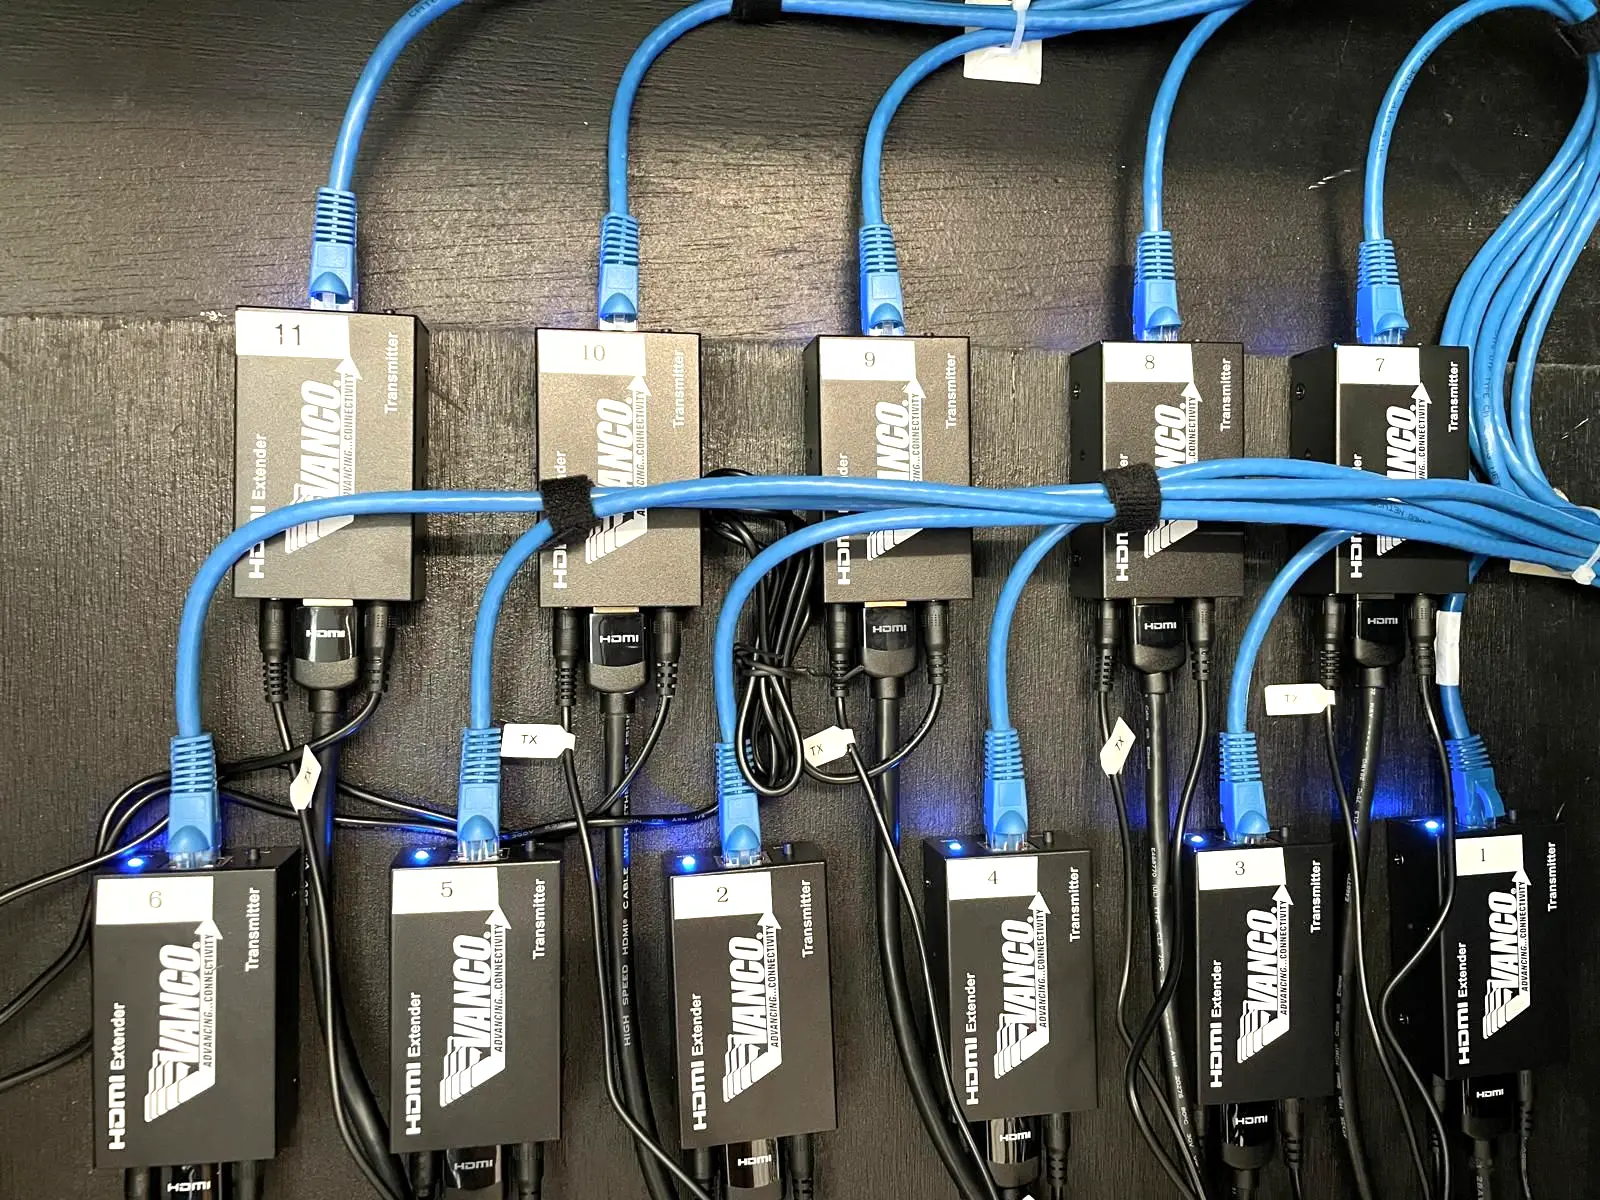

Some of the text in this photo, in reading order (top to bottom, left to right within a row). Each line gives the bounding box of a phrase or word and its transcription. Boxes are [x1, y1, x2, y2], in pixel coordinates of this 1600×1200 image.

[275, 323, 301, 346] 11
[583, 344, 606, 362] 10
[864, 351, 876, 368] 9
[1144, 355, 1155, 370] 8
[1376, 357, 1385, 372] 7
[384, 331, 399, 414] Transmitter
[673, 351, 685, 429] Transmitter
[946, 353, 957, 430] Transmitter
[1220, 358, 1232, 432] Transmitter
[1448, 361, 1459, 433] Transmitter
[252, 433, 267, 500] Extender
[552, 543, 568, 589] HD
[872, 624, 907, 633] HDMI
[1144, 621, 1177, 630] HDMI
[1367, 617, 1398, 625] HDMI
[306, 630, 345, 638] HDMI
[600, 634, 639, 643] HDMI
[521, 734, 538, 745] TX
[1115, 736, 1125, 751] TX
[809, 744, 824, 757] TX
[1480, 848, 1486, 862] 1
[1235, 860, 1245, 876] 3
[1547, 841, 1557, 912] Transmitter
[987, 870, 998, 885] 4
[441, 881, 453, 898] 5
[716, 886, 729, 903] 2
[1310, 860, 1321, 933] Transmitter
[149, 890, 162, 908] 6
[1070, 867, 1080, 942] Transmitter
[532, 878, 546, 960] Transmitter
[802, 879, 814, 958] Transmitter
[245, 887, 261, 972] Transmitter
[1457, 942, 1470, 1065] HDMI Extender
[1210, 960, 1223, 1088] HDMI Extender
[964, 973, 979, 1105] HDMI Extender
[405, 992, 422, 1136] HDMI Extender
[690, 994, 707, 1131] HDMI Extender
[1169, 1050, 1178, 1068] AWM
[108, 1003, 126, 1150] HDMI Extender
[1476, 1088, 1504, 1098] HDMI
[1236, 1115, 1268, 1125] HDMI
[1000, 1130, 1031, 1142] HDMI
[454, 1159, 493, 1171] HDMI
[738, 1154, 772, 1167] HDMI
[167, 1180, 211, 1194] HDMI
